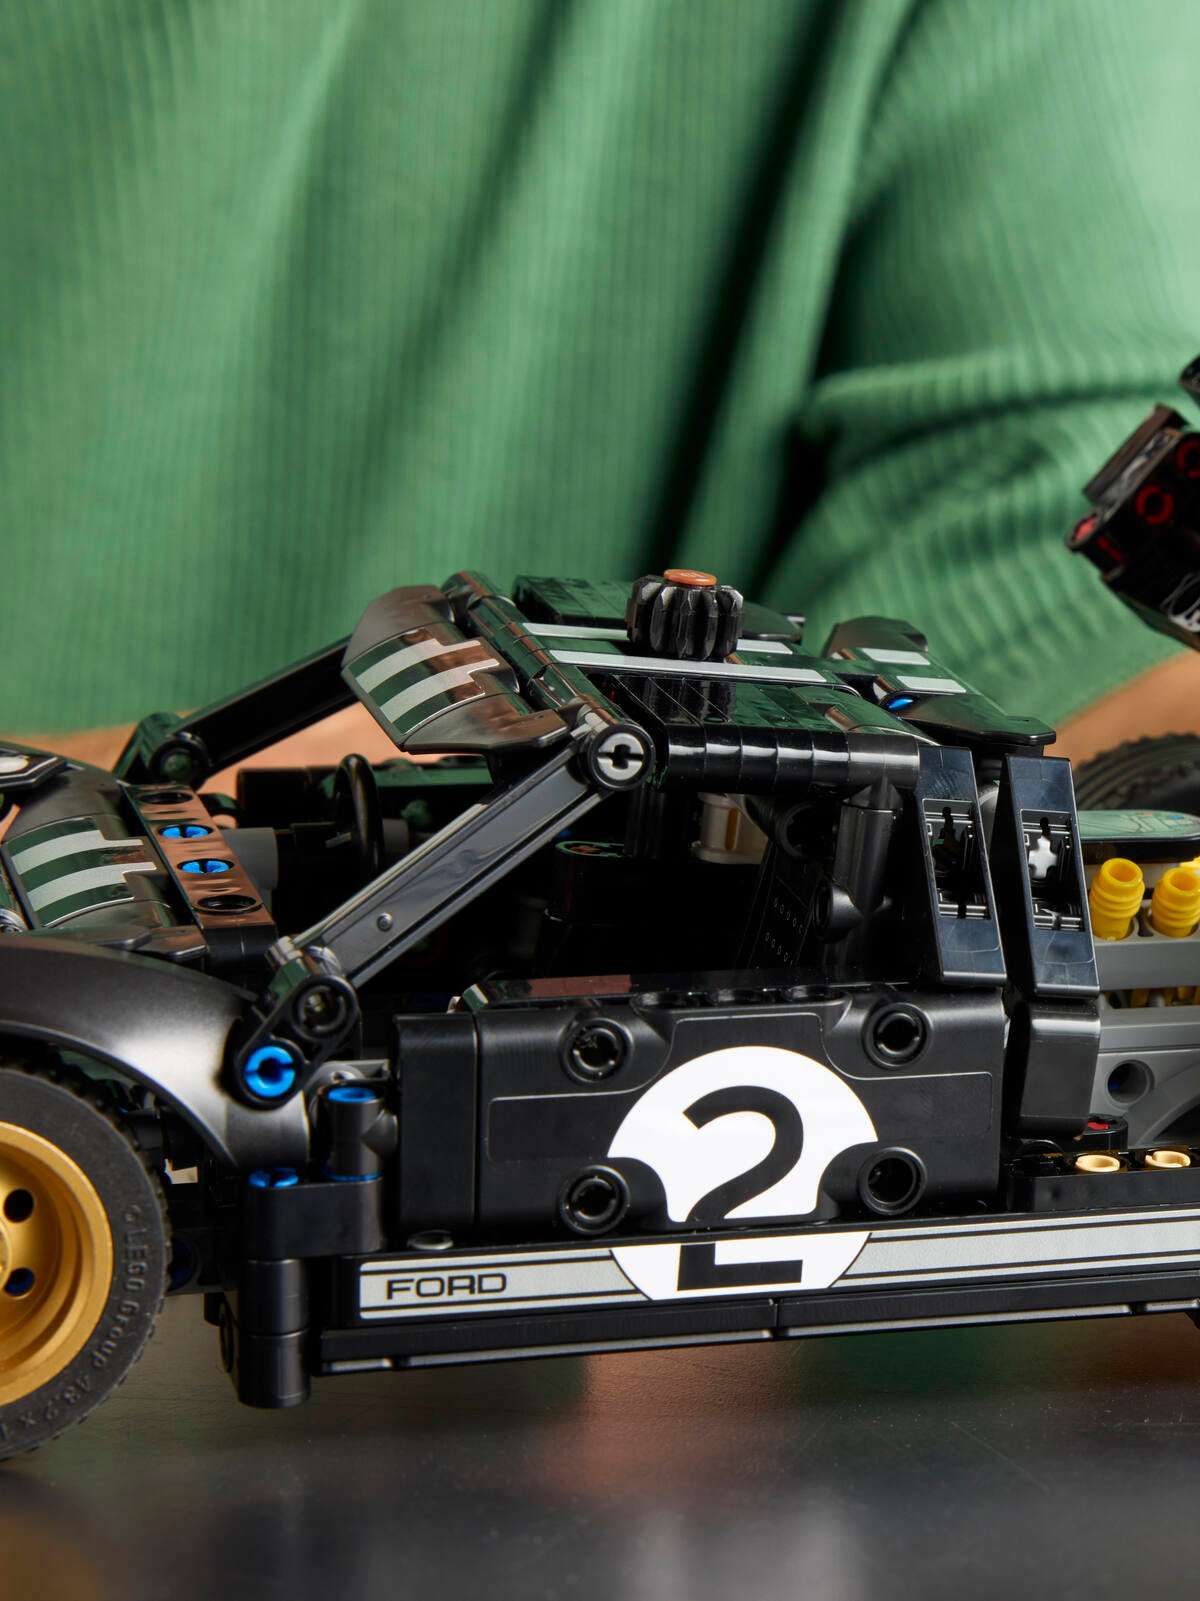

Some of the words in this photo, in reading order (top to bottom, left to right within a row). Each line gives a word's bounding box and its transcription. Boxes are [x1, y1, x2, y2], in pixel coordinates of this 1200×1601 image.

[678, 1086, 804, 1291] 2
[386, 1272, 506, 1300] FORD
[93, 1299, 140, 1367] Group
